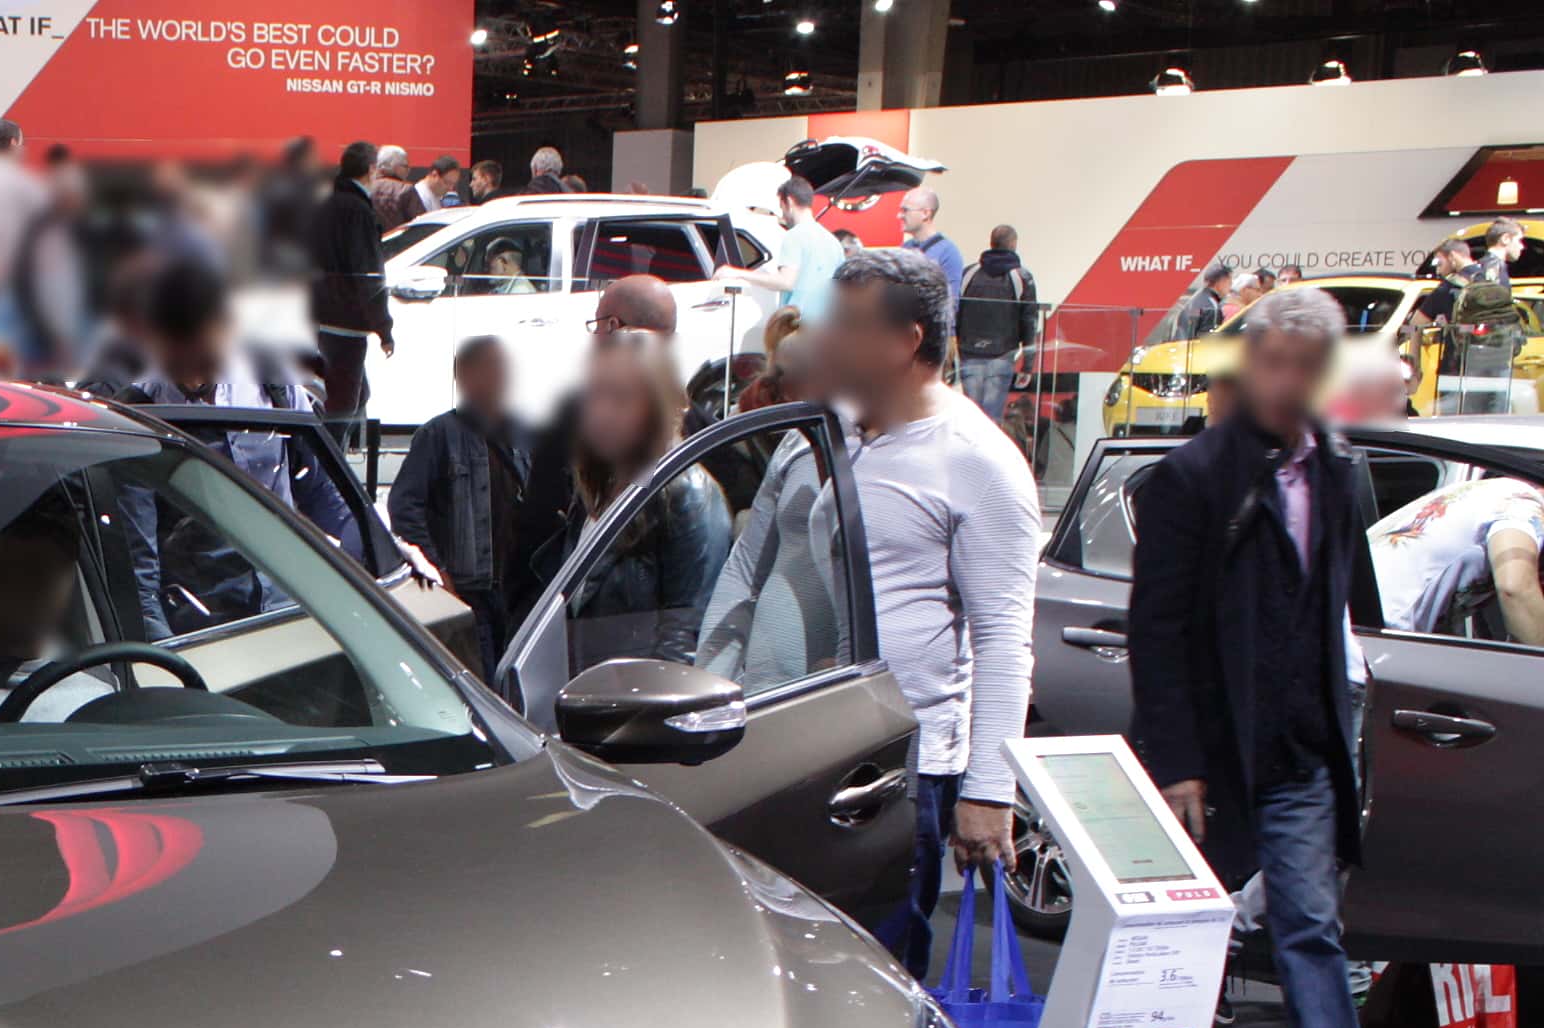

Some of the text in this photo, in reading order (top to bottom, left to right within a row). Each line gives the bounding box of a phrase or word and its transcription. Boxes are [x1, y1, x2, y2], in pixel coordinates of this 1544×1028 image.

[86, 17, 399, 48] THE WORLD'S BEST COULD
[226, 48, 435, 75] GO EVEN FASTER?
[286, 78, 435, 96] NISSAN GT-R NISMO
[1120, 255, 1173, 272] WHAT
[1217, 254, 1252, 270] YOU
[1258, 252, 1319, 269] COULD
[1324, 250, 1395, 267] CREATE
